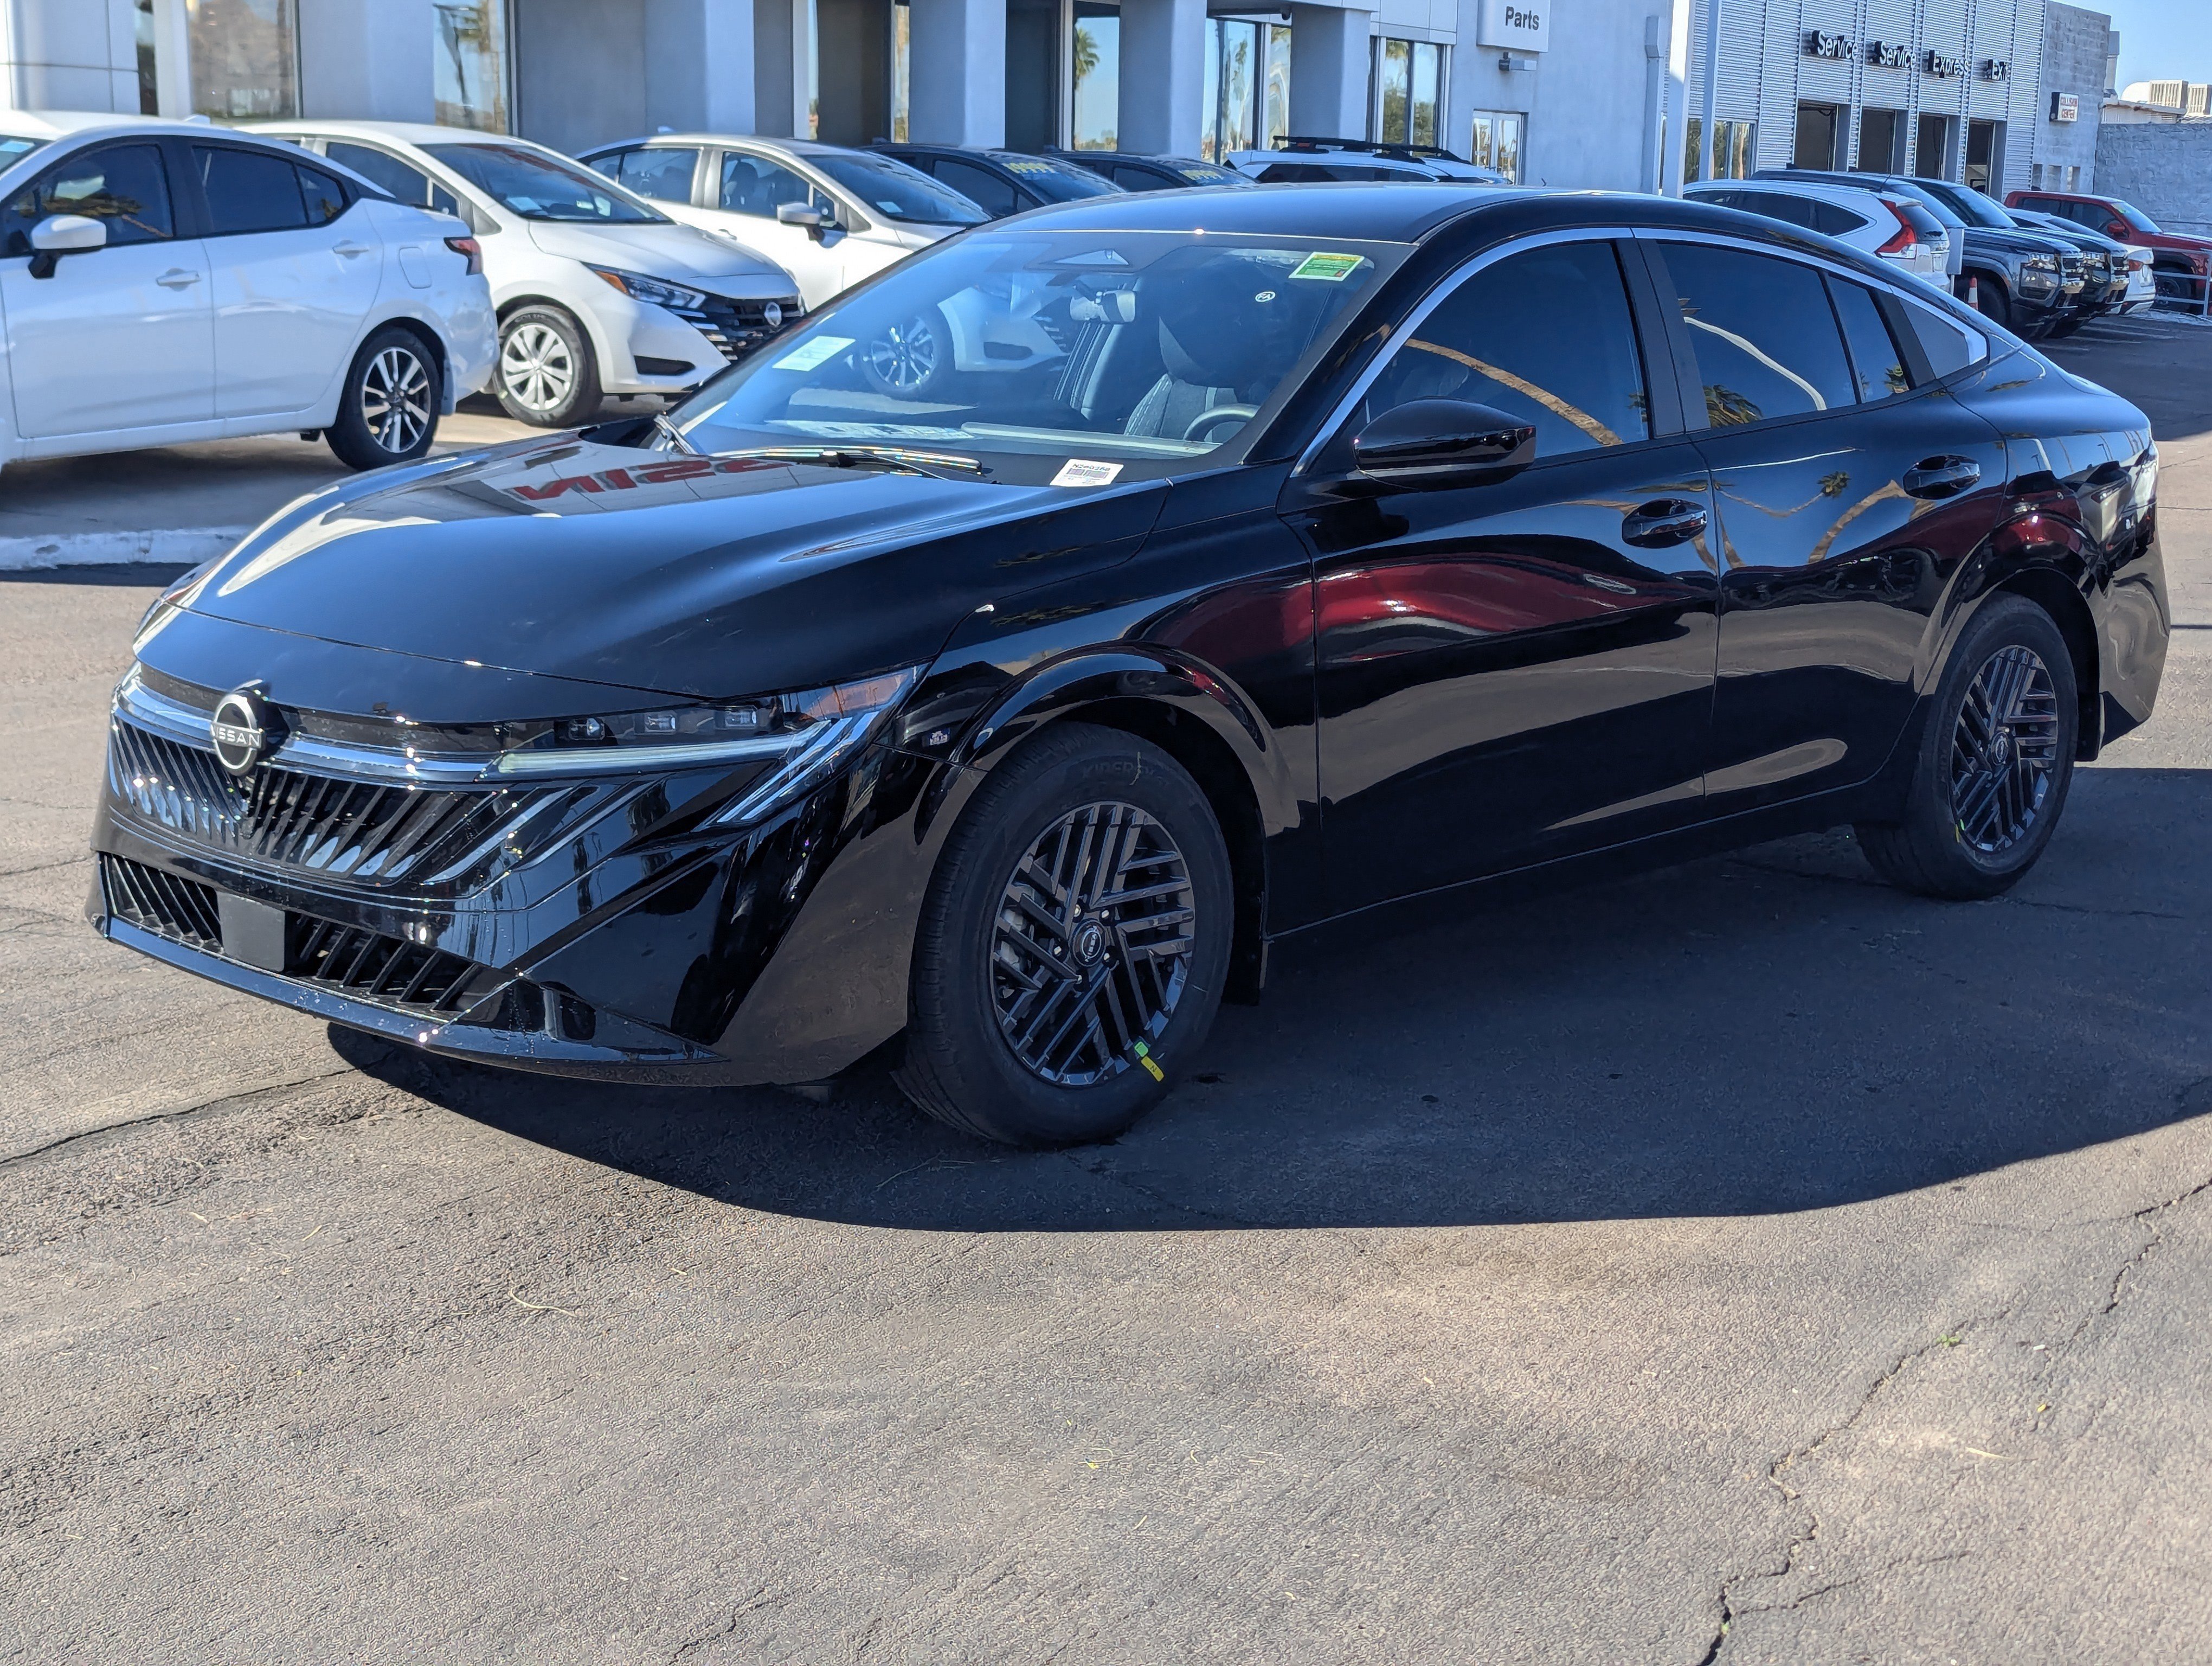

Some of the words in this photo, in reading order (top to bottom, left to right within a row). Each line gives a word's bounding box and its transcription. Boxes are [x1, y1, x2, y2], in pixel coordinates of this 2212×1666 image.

[1505, 6, 1540, 30] Parts
[1817, 30, 1859, 60] Service
[1879, 41, 1917, 68] Service
